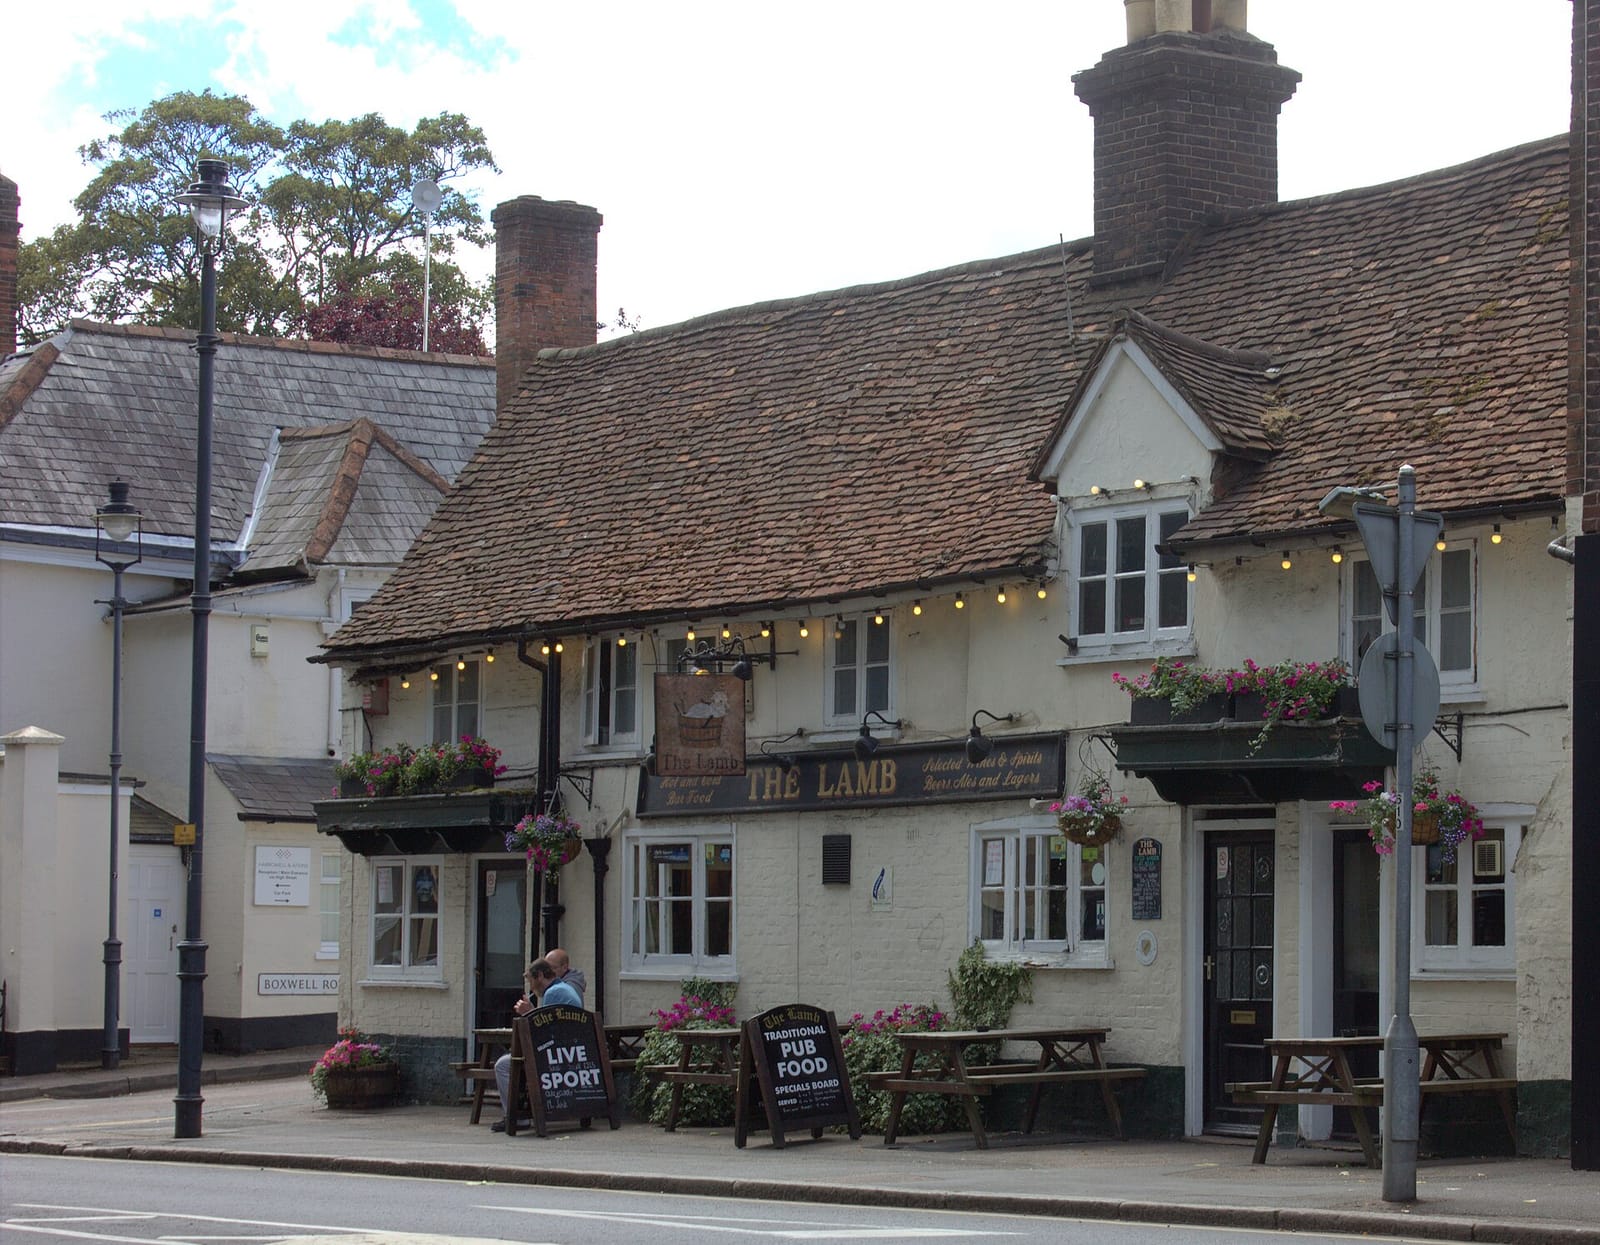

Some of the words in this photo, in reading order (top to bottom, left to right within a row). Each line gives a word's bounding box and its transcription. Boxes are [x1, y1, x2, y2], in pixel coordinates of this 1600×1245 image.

[664, 753, 691, 770] The
[697, 753, 738, 770] Lamb
[922, 757, 962, 772] Selected
[998, 751, 1007, 767] &
[1010, 750, 1042, 768] Spirits
[746, 765, 800, 801] THE
[817, 758, 897, 798] LAMB
[979, 772, 1002, 786] and
[1002, 770, 1040, 789] Lagers
[687, 789, 714, 804] Food
[1140, 840, 1154, 848] THE
[264, 979, 318, 990] BOXWELL
[533, 1013, 554, 1028] The
[555, 1007, 588, 1024] Lamb
[763, 1014, 785, 1029] The
[786, 1007, 820, 1024] Lamb
[764, 1025, 826, 1041] TRADITIONAL
[546, 1045, 588, 1065] LIVE
[780, 1039, 817, 1058] PUB
[777, 1057, 828, 1078] FOOD
[540, 1068, 600, 1090] SPORT
[774, 1083, 811, 1095] SPECIALS
[812, 1079, 839, 1090] BOARD
[778, 1098, 797, 1106] SERVED
